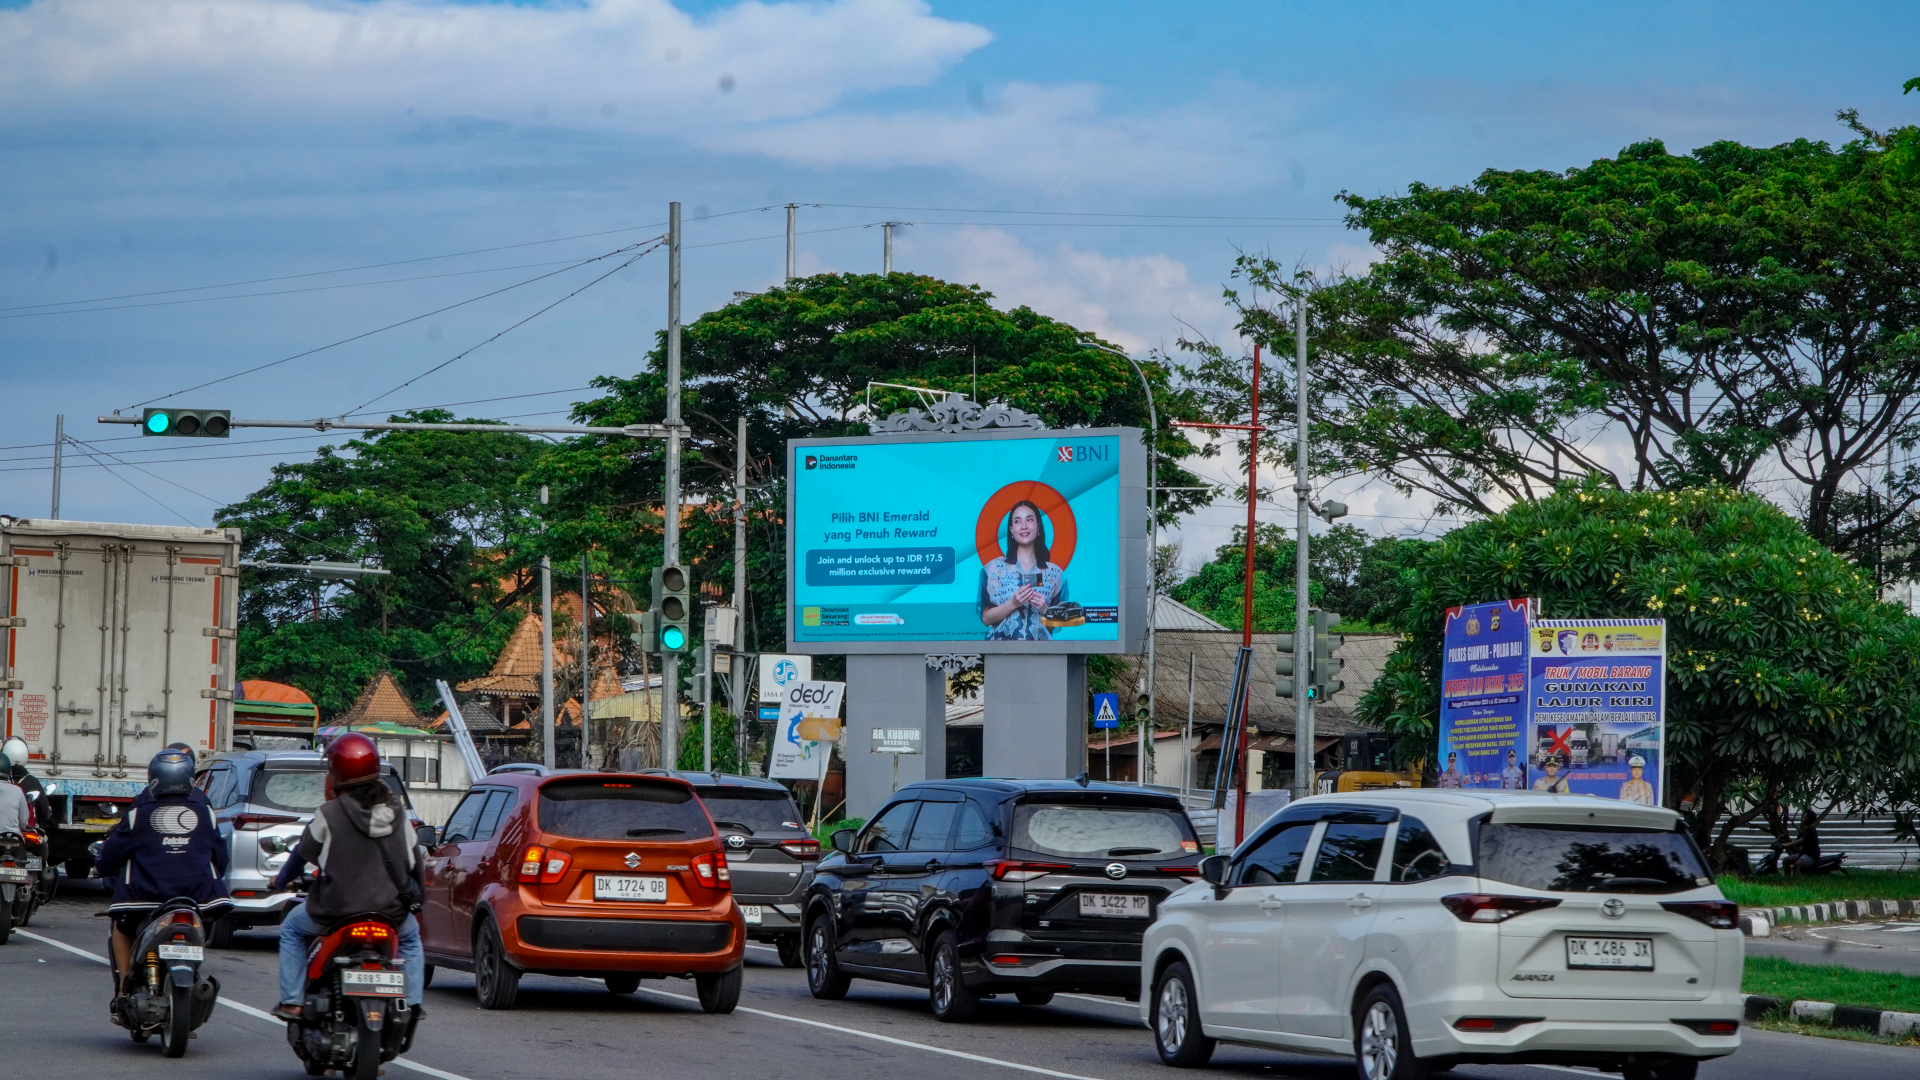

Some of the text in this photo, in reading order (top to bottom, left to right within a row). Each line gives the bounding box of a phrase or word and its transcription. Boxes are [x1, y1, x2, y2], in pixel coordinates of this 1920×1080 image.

[1076, 445, 1109, 461] BNI
[832, 510, 929, 523] Pilih BNI Emerald
[824, 527, 937, 542] yang Penuh Reward
[818, 556, 834, 564] Join
[837, 556, 852, 564] and
[855, 555, 880, 563] unlock
[883, 557, 893, 565] up
[829, 566, 931, 576] million exclusive rewards
[1448, 647, 1466, 663] POLRES
[1468, 645, 1488, 661] GIANYAR
[1493, 643, 1509, 658] POLDA
[1510, 641, 1522, 656] BALI
[1610, 666, 1652, 679] BARANG
[1445, 678, 1469, 698] OPERASI
[1508, 673, 1524, 692] 2025
[1545, 682, 1645, 693] GUNAKAN
[790, 684, 833, 704] deds
[1537, 696, 1653, 707] LAJUR KIRI
[1535, 712, 1656, 723] DEMI KESELAMATAN DALAM BERLALU LINTAS
[872, 729, 886, 740] BR.
[1318, 780, 1333, 794] CAT
[598, 879, 664, 892] DK 1724 QB
[1083, 895, 1146, 909] DK 1422 MP
[743, 907, 759, 917] KAB
[1571, 940, 1649, 957] DK 1486 JX
[347, 973, 352, 981] P
